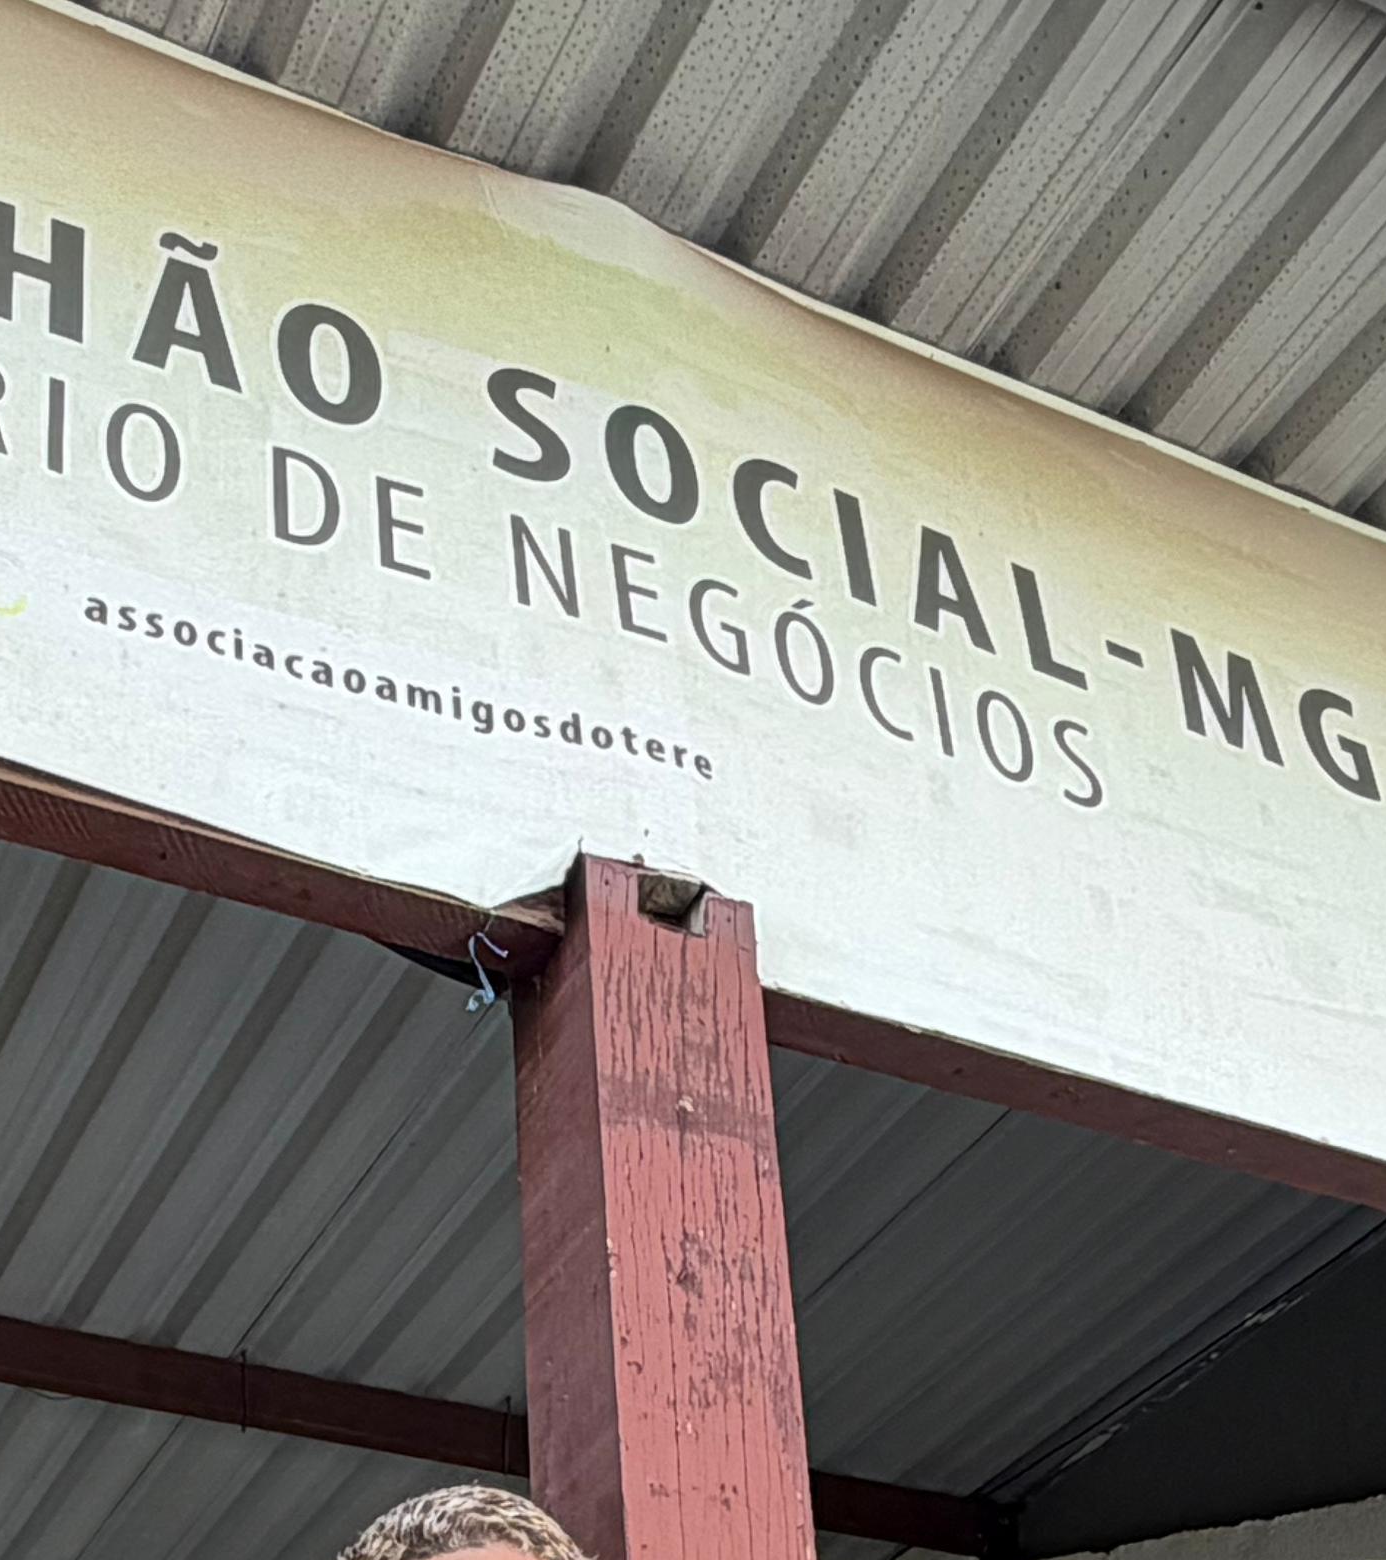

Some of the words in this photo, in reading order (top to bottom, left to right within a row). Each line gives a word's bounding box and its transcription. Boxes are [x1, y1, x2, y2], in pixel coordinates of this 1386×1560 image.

[83, 596, 714, 781] associacaoamigosdotere
[271, 446, 431, 580] DE
[510, 515, 1103, 808] NEGÓCIOS
[486, 367, 1381, 801] SOCIAL-MG
